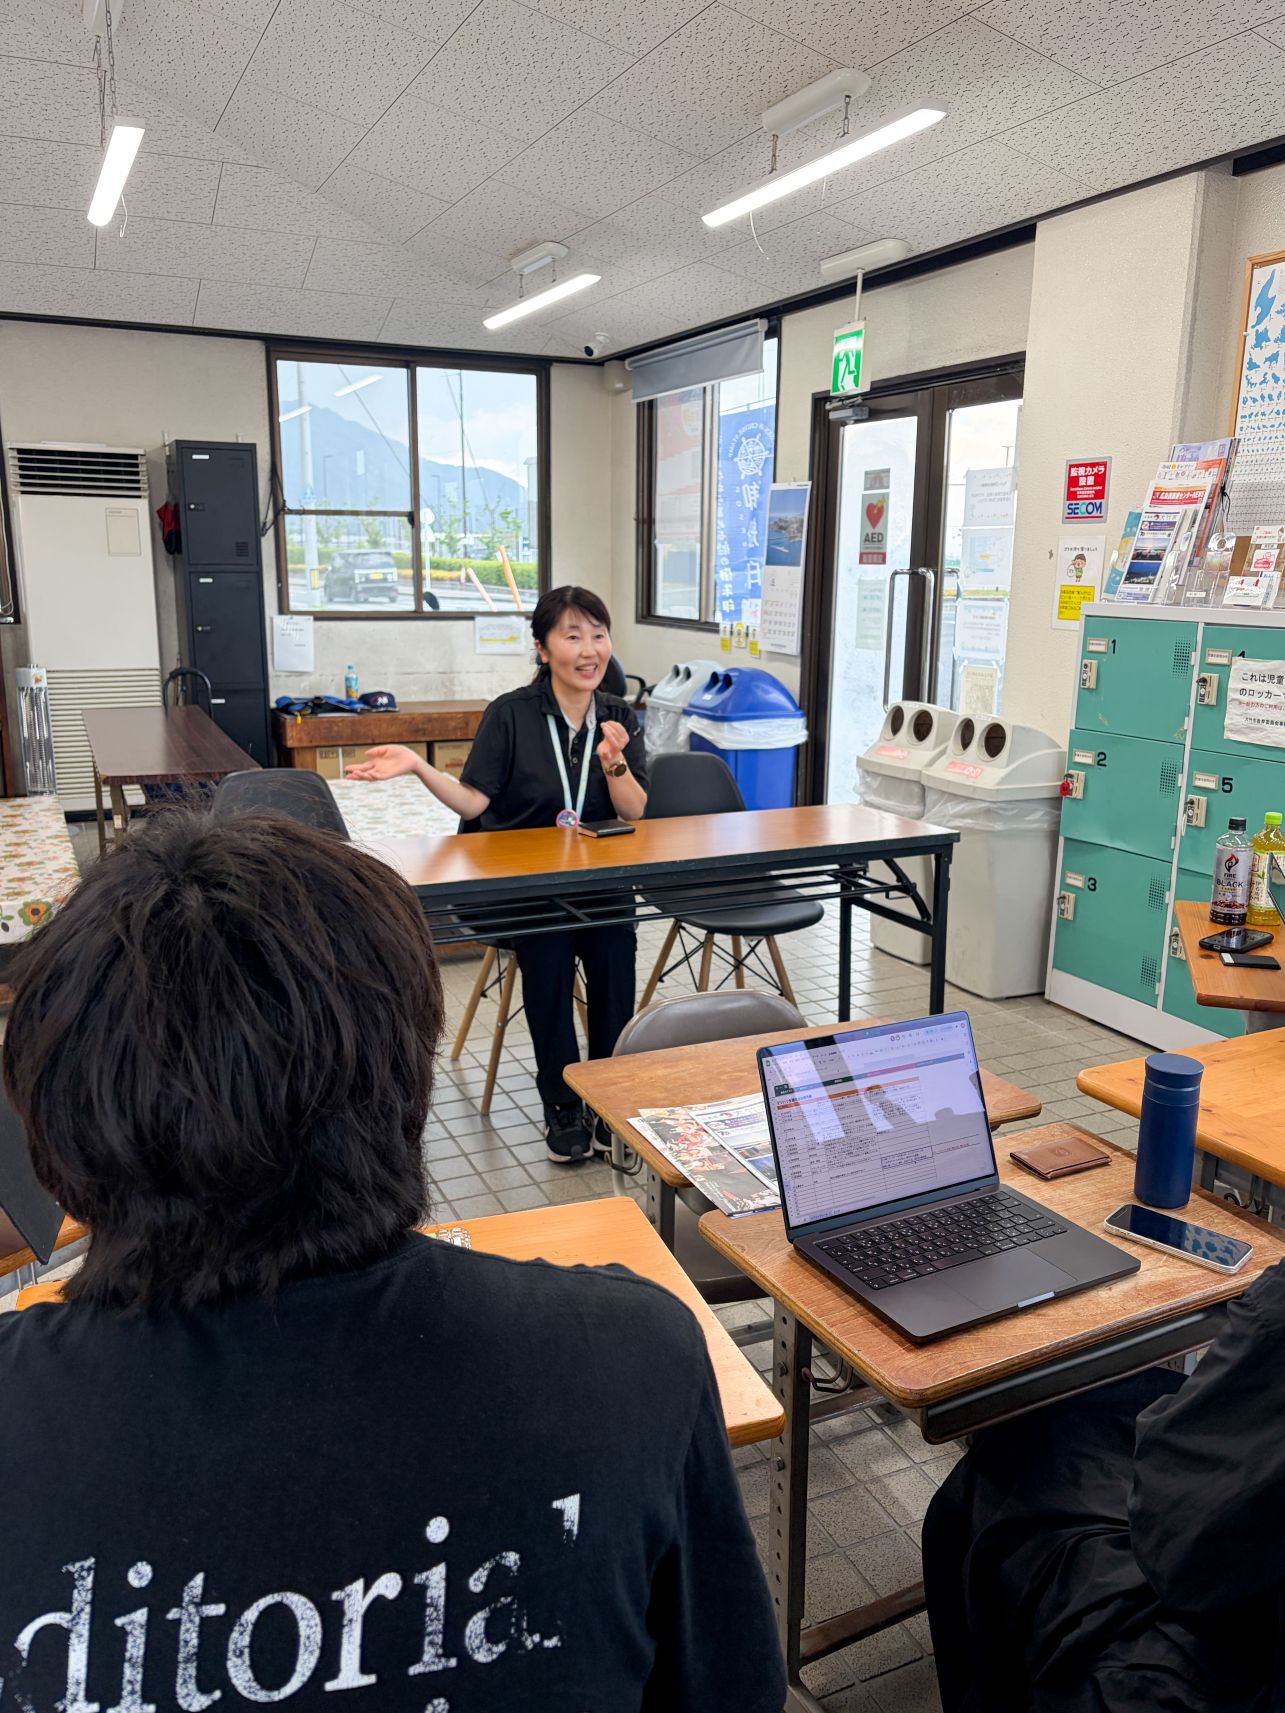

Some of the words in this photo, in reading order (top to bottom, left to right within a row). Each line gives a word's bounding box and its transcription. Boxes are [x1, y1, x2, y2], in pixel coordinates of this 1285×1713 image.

[1070, 465, 1105, 477] 監視カメラ
[1078, 476, 1095, 486] 設置
[1067, 501, 1103, 515] SECOM
[863, 532, 885, 544] AED
[1110, 639, 1117, 654] 1
[1096, 751, 1107, 768] 2
[1221, 777, 1233, 794] 5
[1087, 877, 1097, 892] 3
[1216, 878, 1244, 889] BLACK
